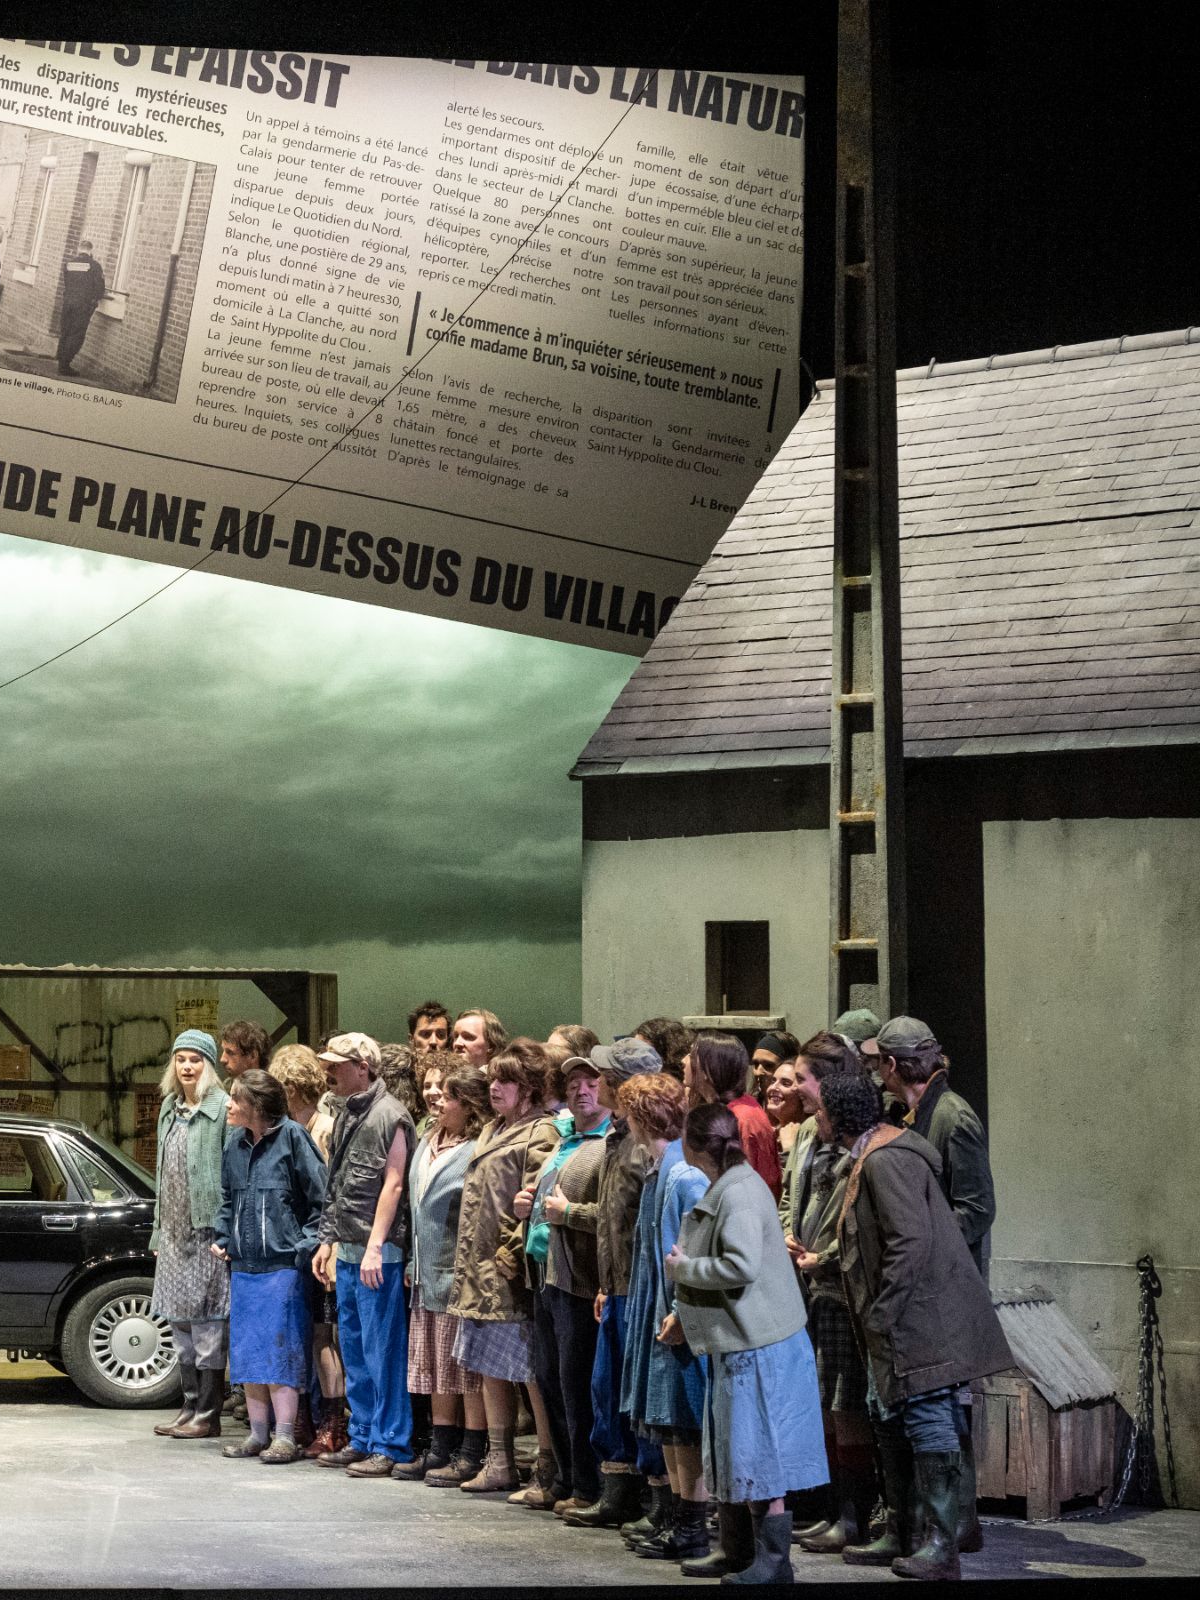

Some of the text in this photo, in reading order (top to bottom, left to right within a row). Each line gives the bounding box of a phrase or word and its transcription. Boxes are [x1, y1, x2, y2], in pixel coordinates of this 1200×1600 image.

[37, 63, 119, 92] disparitions
[136, 86, 228, 115] mystérieuses
[609, 66, 658, 108] LA
[22, 103, 73, 124] restent
[77, 111, 167, 143] introuvables.
[60, 87, 109, 111] Malgré
[118, 99, 138, 117] les
[146, 109, 224, 136] recherches,
[246, 110, 428, 158] Un appel à témoins a été lancé
[447, 101, 544, 131] alerté les secours.
[426, 327, 760, 409] confie madame Brun, sa voisine, toute tremblante.
[440, 307, 454, 324] Je
[457, 313, 530, 340] commence
[533, 327, 542, 342] à
[546, 332, 623, 359] m'inquiéter
[626, 349, 716, 380] sérieusement
[732, 373, 763, 389] nous
[14, 378, 22, 387] le
[24, 382, 54, 394] village.
[56, 388, 81, 399] Photo
[93, 395, 122, 408] BALAIS
[69, 477, 207, 546] PLANE
[210, 506, 461, 596] AU-DESSUS
[470, 556, 534, 612] DU
